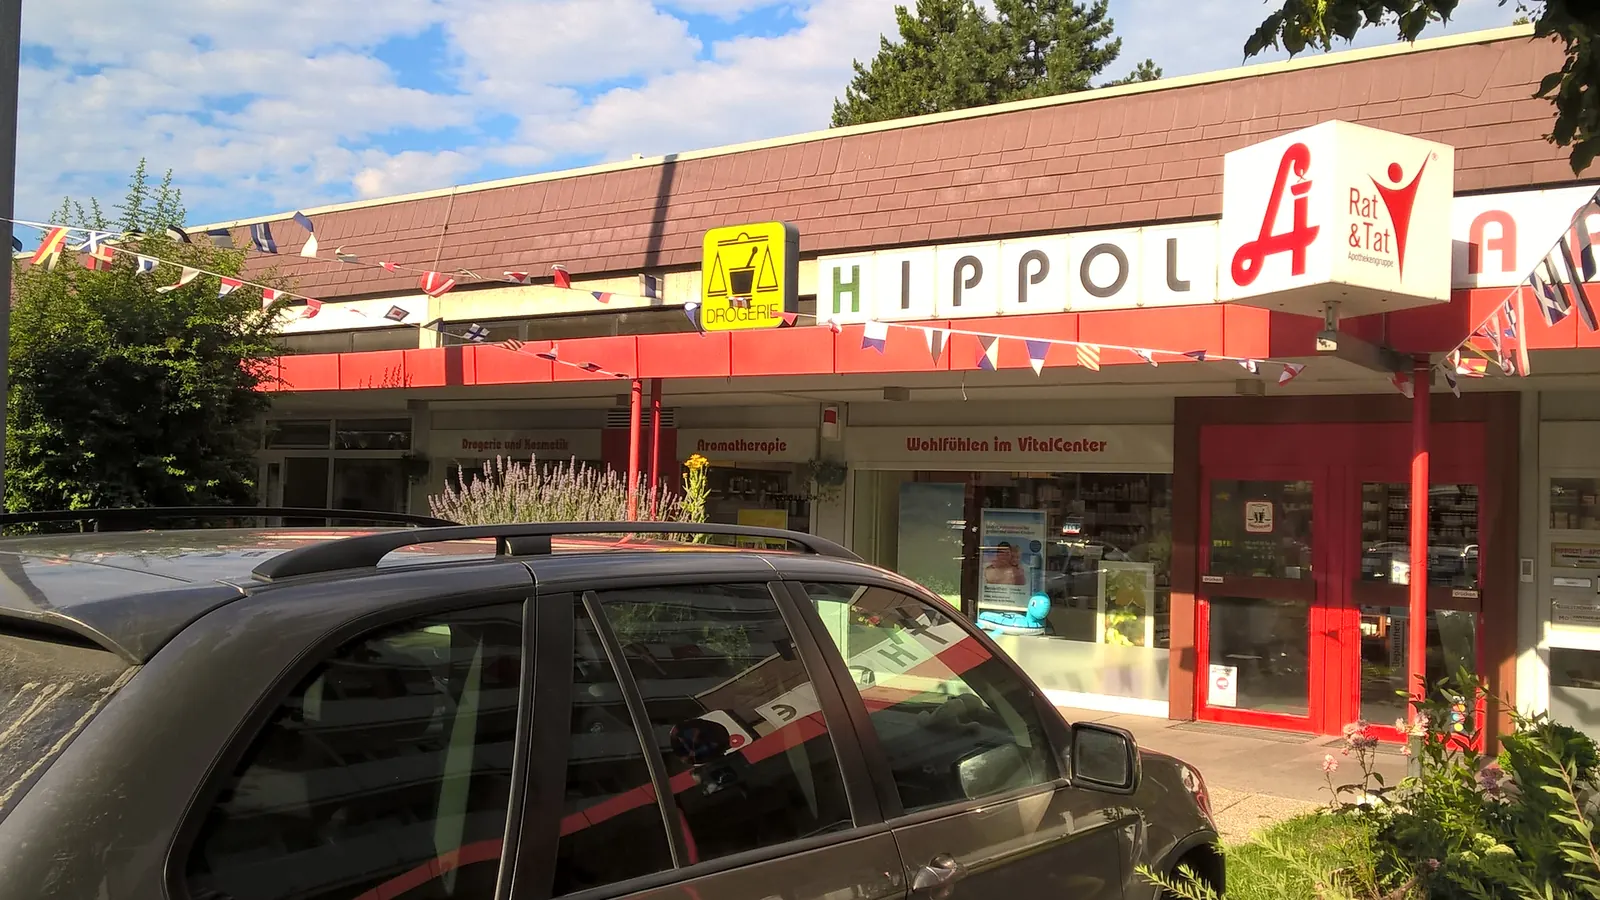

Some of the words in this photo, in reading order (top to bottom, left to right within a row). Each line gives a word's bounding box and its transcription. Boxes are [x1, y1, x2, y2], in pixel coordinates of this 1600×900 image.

[1349, 187, 1378, 219] Rat
[1347, 251, 1394, 267] Apothekengruppe
[706, 303, 779, 324] DROGERIE
[461, 438, 501, 452] Drogerie
[505, 439, 521, 450] und
[524, 438, 569, 451] Kosmetik
[697, 438, 787, 454] Aromatherapie
[906, 437, 989, 452] Wohlfühlen
[994, 437, 1012, 452] im
[1017, 437, 1107, 452] VitalCenter
